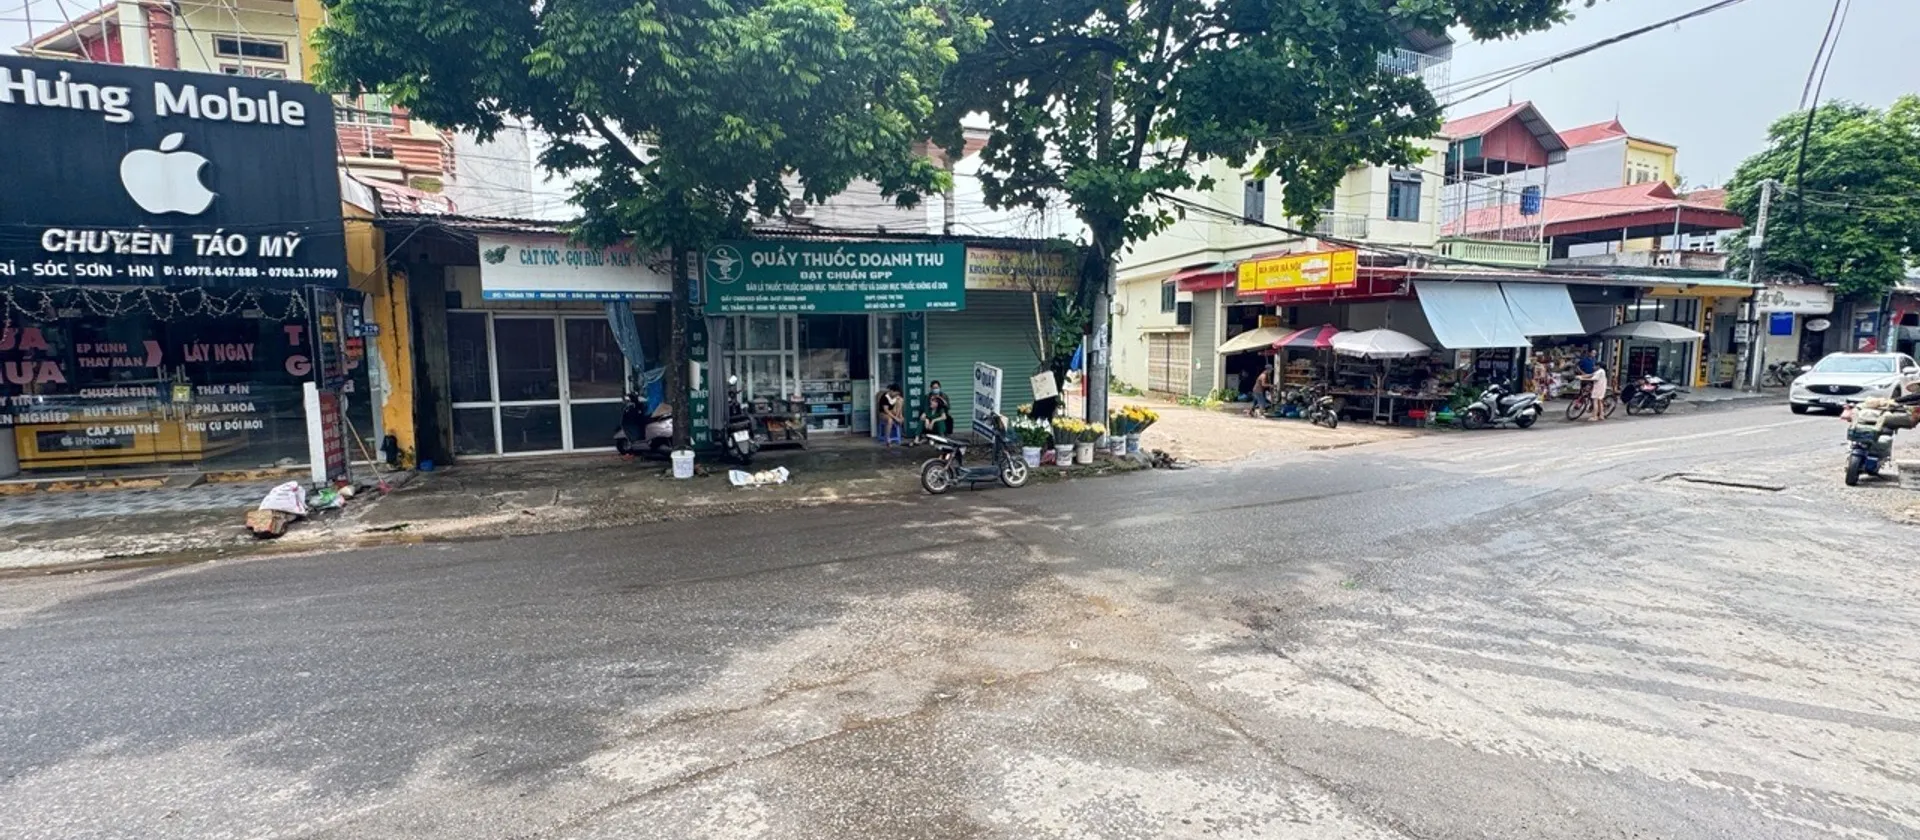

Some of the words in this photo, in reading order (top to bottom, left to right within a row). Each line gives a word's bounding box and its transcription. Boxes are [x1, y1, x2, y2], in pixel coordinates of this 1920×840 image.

[0, 67, 134, 124] Hưng
[154, 82, 306, 127] Mobile
[192, 228, 248, 258] TÁO
[259, 231, 303, 258] MỸ
[802, 246, 856, 267] THUỐC
[859, 253, 912, 267] DOANH
[915, 253, 944, 267] THU
[32, 260, 69, 276] SÓC
[75, 262, 113, 277] SƠN
[128, 265, 154, 277] HN
[184, 266, 258, 278] 0978.647.888
[870, 271, 893, 280] GPP
[214, 343, 255, 362] NGAY
[78, 357, 111, 368] THAY
[196, 385, 226, 396] THAY
[114, 424, 136, 436] SIM
[186, 421, 207, 432] THU
[75, 434, 116, 447] iPhone
